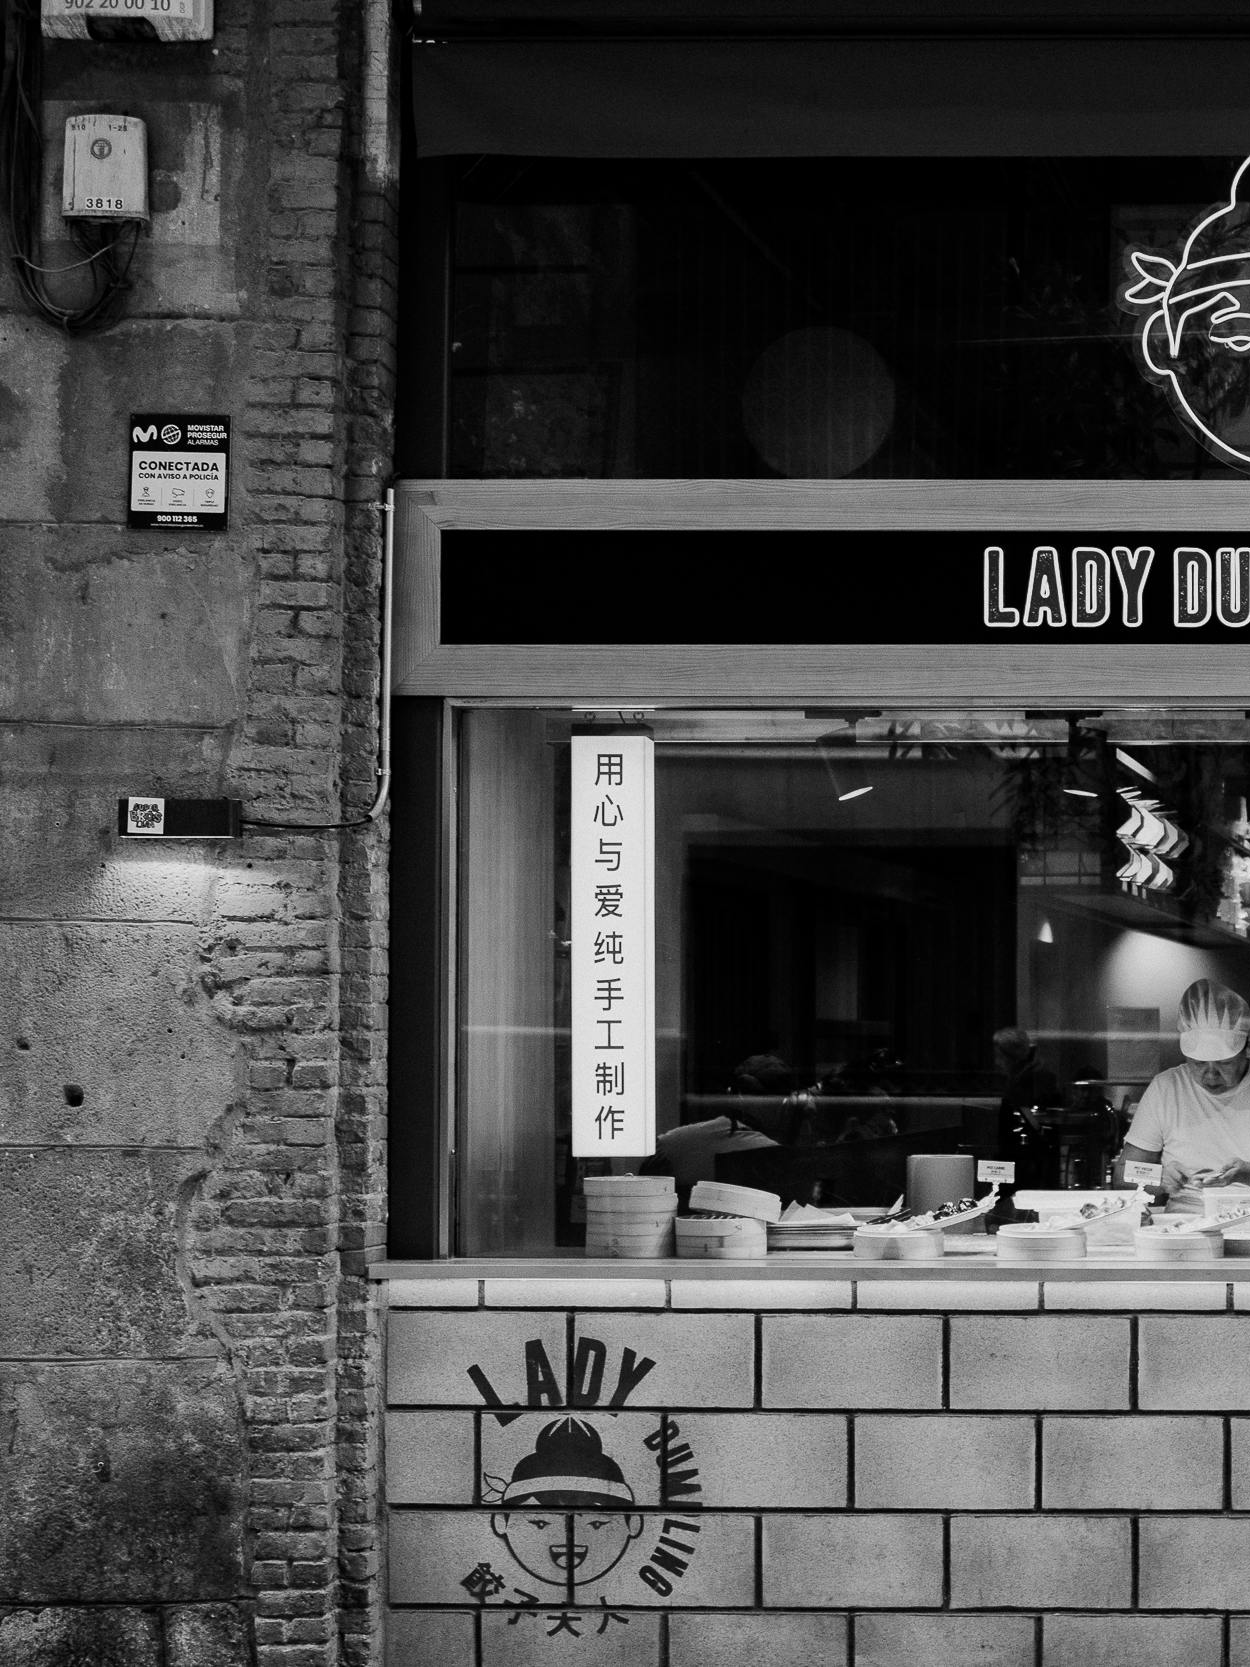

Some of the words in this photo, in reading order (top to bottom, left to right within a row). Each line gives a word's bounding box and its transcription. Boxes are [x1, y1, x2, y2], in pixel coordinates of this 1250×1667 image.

[100, 0, 118, 9] 20
[124, 0, 144, 10] 00
[150, 0, 170, 11] 10
[86, 198, 123, 209] 3818
[187, 424, 225, 432] MOVISTAR
[187, 431, 228, 439] PROSEGUR
[138, 461, 219, 472] CONECTADA
[157, 472, 181, 480] AVISO
[189, 472, 219, 481] POLICÍA
[172, 515, 183, 523] 112
[183, 515, 198, 523] 365
[983, 546, 1155, 628] LADY
[592, 752, 626, 1141] 用心与爱纯手工制作
[466, 1336, 657, 1427] LADY
